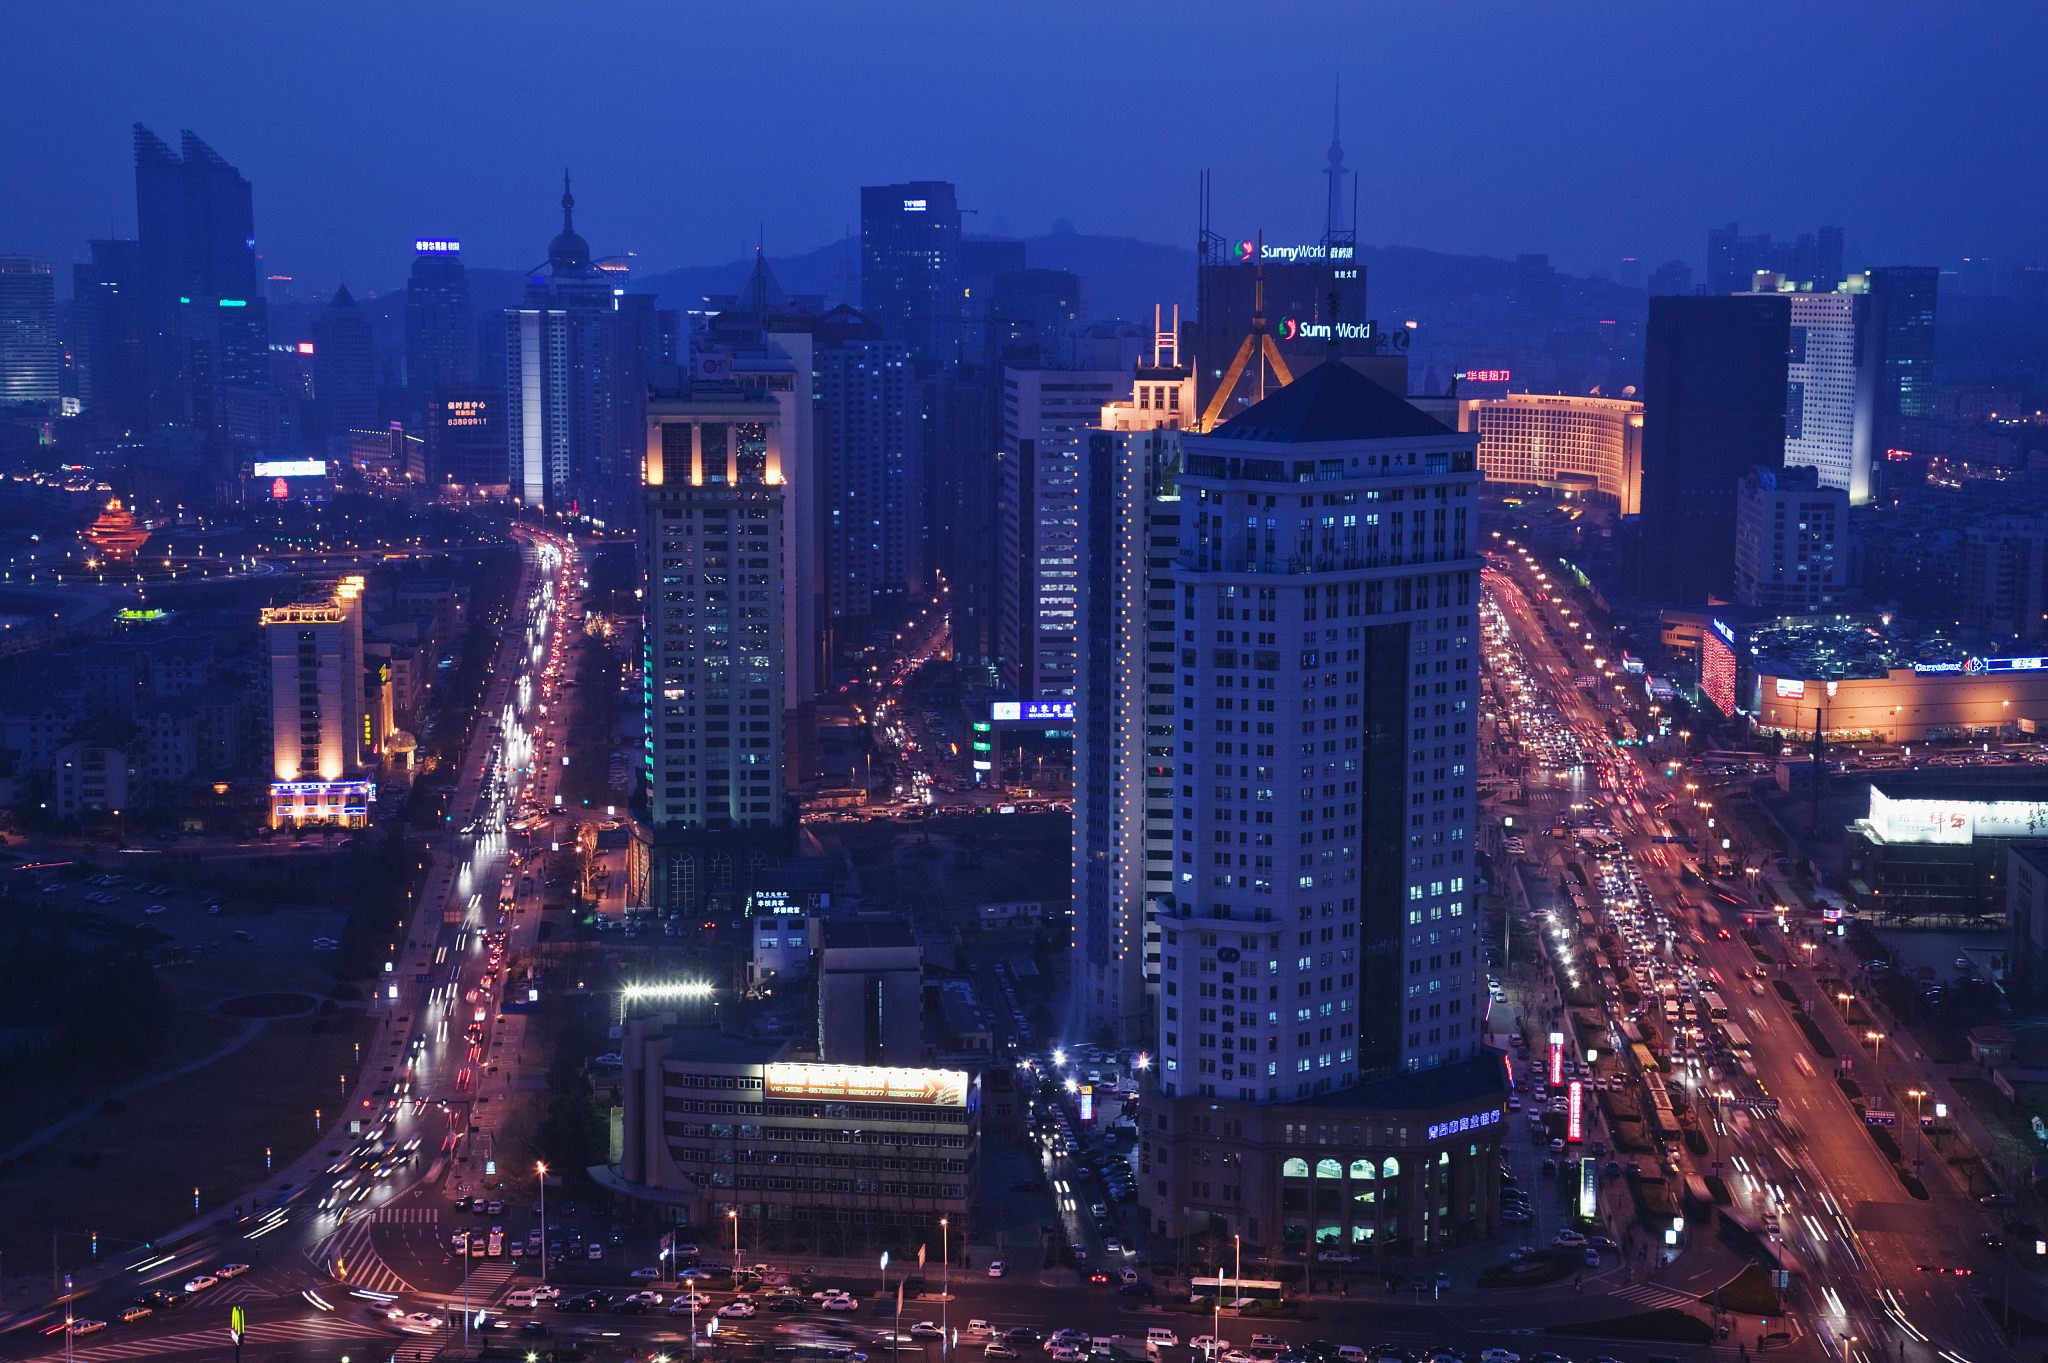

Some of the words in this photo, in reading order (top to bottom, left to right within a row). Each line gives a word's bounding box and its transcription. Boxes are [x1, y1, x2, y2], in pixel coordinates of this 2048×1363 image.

[1260, 245, 1326, 261] SunnyWorld
[1329, 247, 1353, 259] 数码港
[1466, 370, 1510, 381] 华电热力
[1368, 452, 1416, 468] 华普大厦
[1221, 971, 1235, 1081] 青岛市商业银行
[1428, 1109, 1501, 1140] 青岛市商业银行
